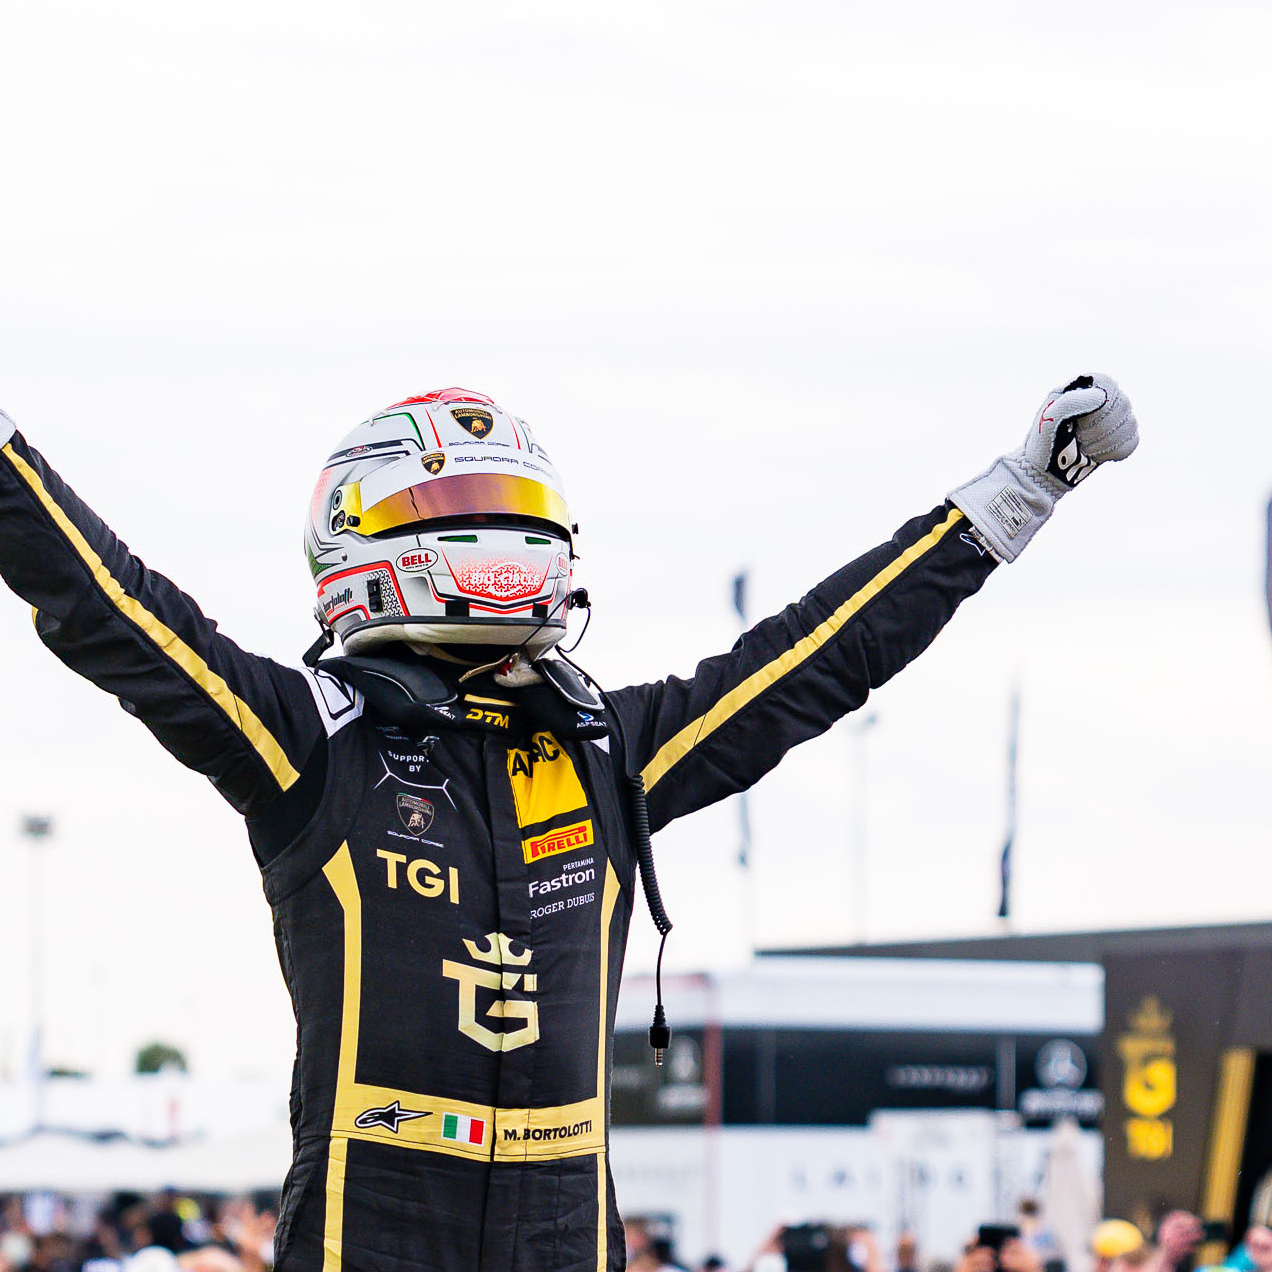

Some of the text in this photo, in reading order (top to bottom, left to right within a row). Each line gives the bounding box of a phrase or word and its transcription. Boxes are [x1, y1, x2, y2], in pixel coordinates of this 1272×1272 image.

[454, 456, 519, 465] SQUADRA
[401, 553, 432, 567] BELL
[466, 708, 510, 729] DTM
[409, 764, 422, 773] BY
[531, 825, 588, 859] PIRELLI
[562, 857, 595, 872] PERTAMINA
[376, 848, 460, 905] TGI
[528, 868, 596, 898] Fastron
[530, 901, 566, 920] ROGER
[503, 1119, 593, 1141] M. BORTOLOTTI
